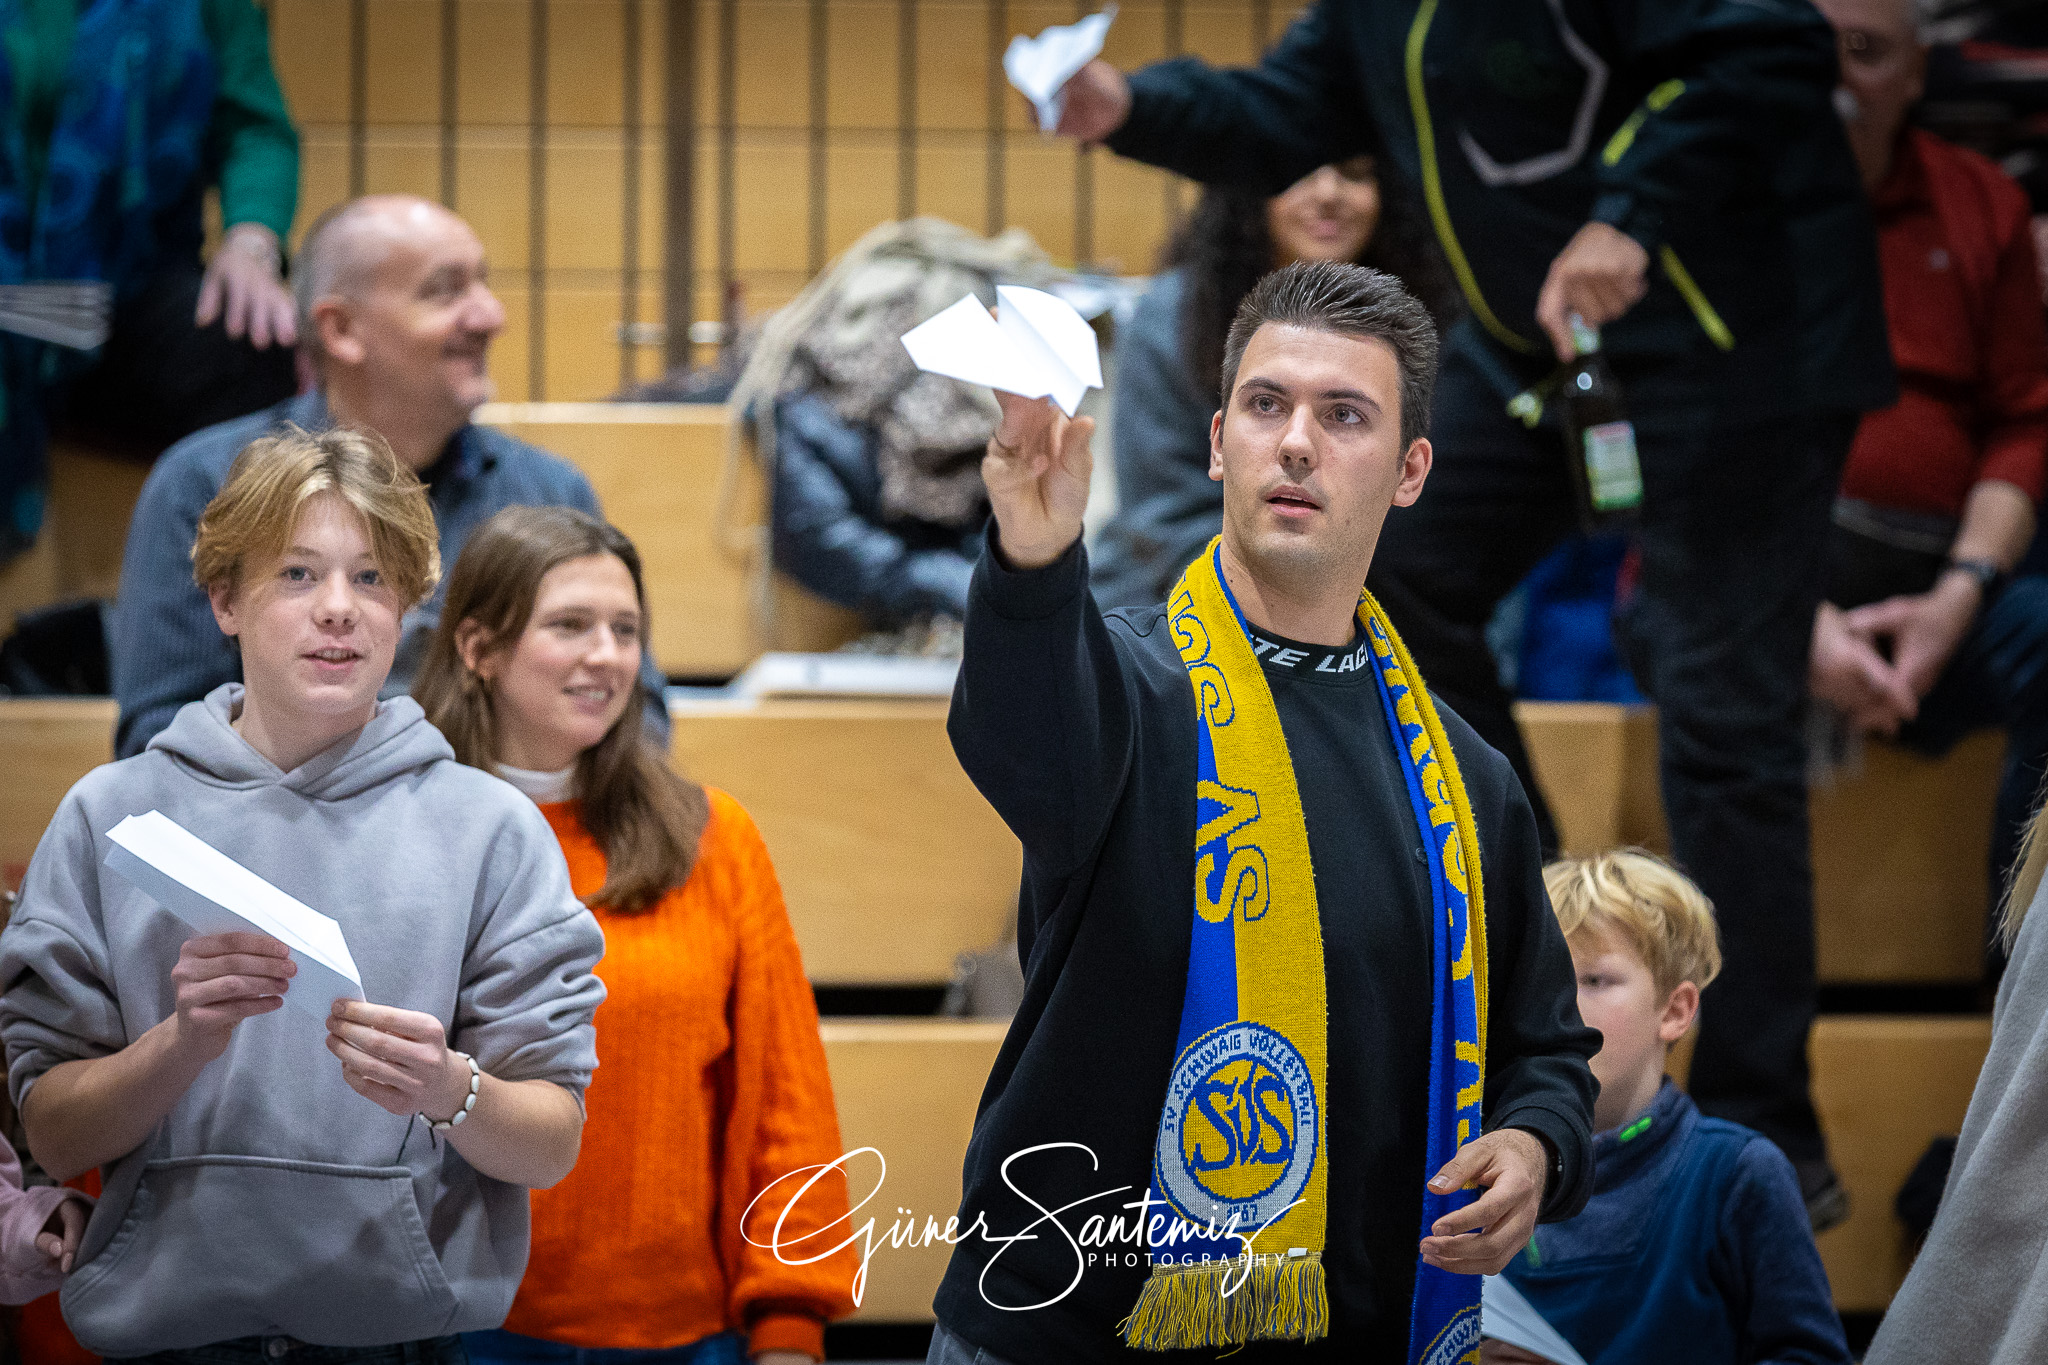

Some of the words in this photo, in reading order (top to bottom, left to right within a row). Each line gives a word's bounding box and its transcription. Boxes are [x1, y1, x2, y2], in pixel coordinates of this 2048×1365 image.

[1250, 633, 1310, 667] TE
[1315, 640, 1369, 672] LAC
[1175, 1033, 1241, 1100] SCHWAIG
[1250, 1033, 1312, 1127] VOLLEYBALL
